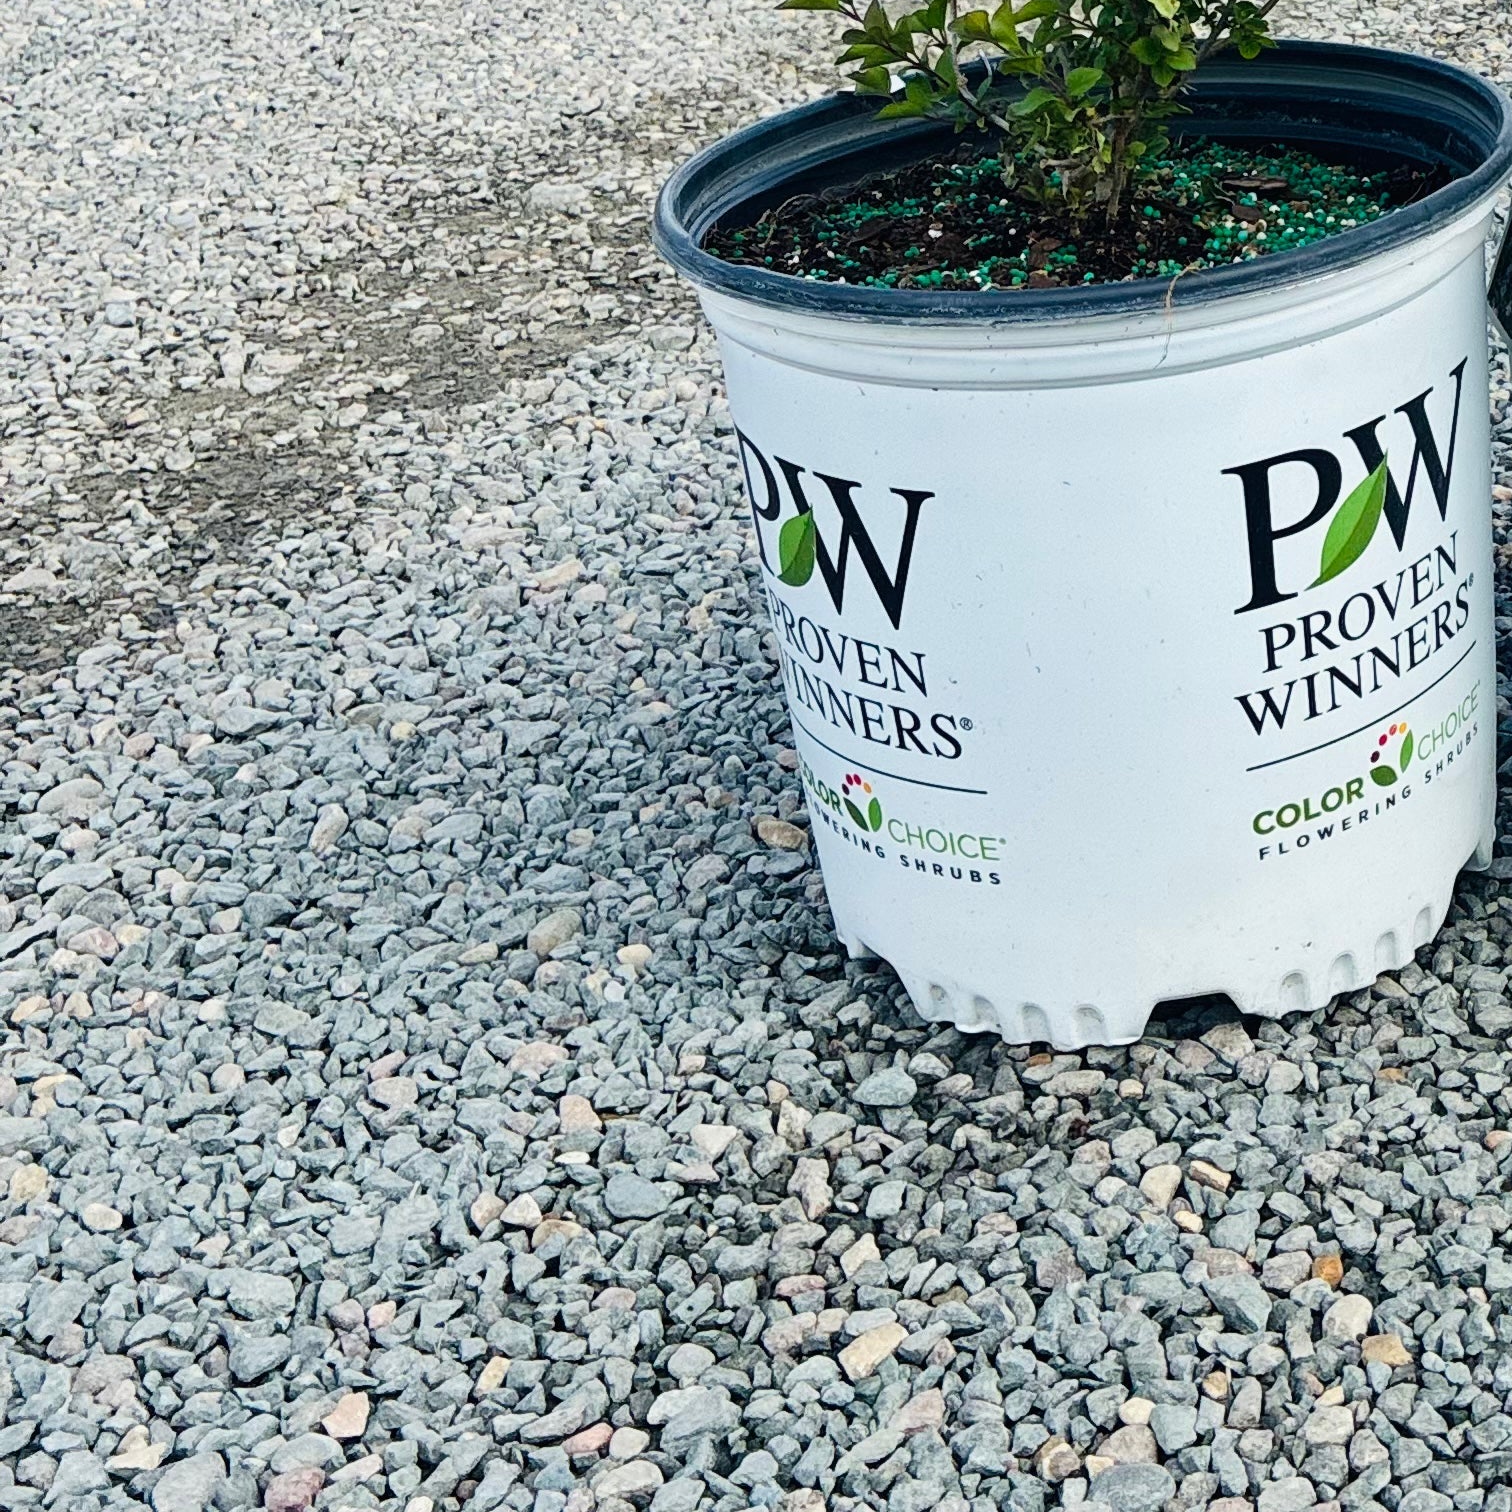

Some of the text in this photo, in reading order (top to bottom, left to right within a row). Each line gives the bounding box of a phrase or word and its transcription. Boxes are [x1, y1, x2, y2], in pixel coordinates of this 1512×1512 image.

[1220, 355, 1468, 615] PW
[767, 586, 928, 698] PROVEN
[1258, 530, 1459, 673] PROVEN
[1252, 777, 1364, 835] COLOR
[1258, 721, 1478, 860] FLOWERING SHRUBS
[900, 855, 1001, 885] SHRUBS
